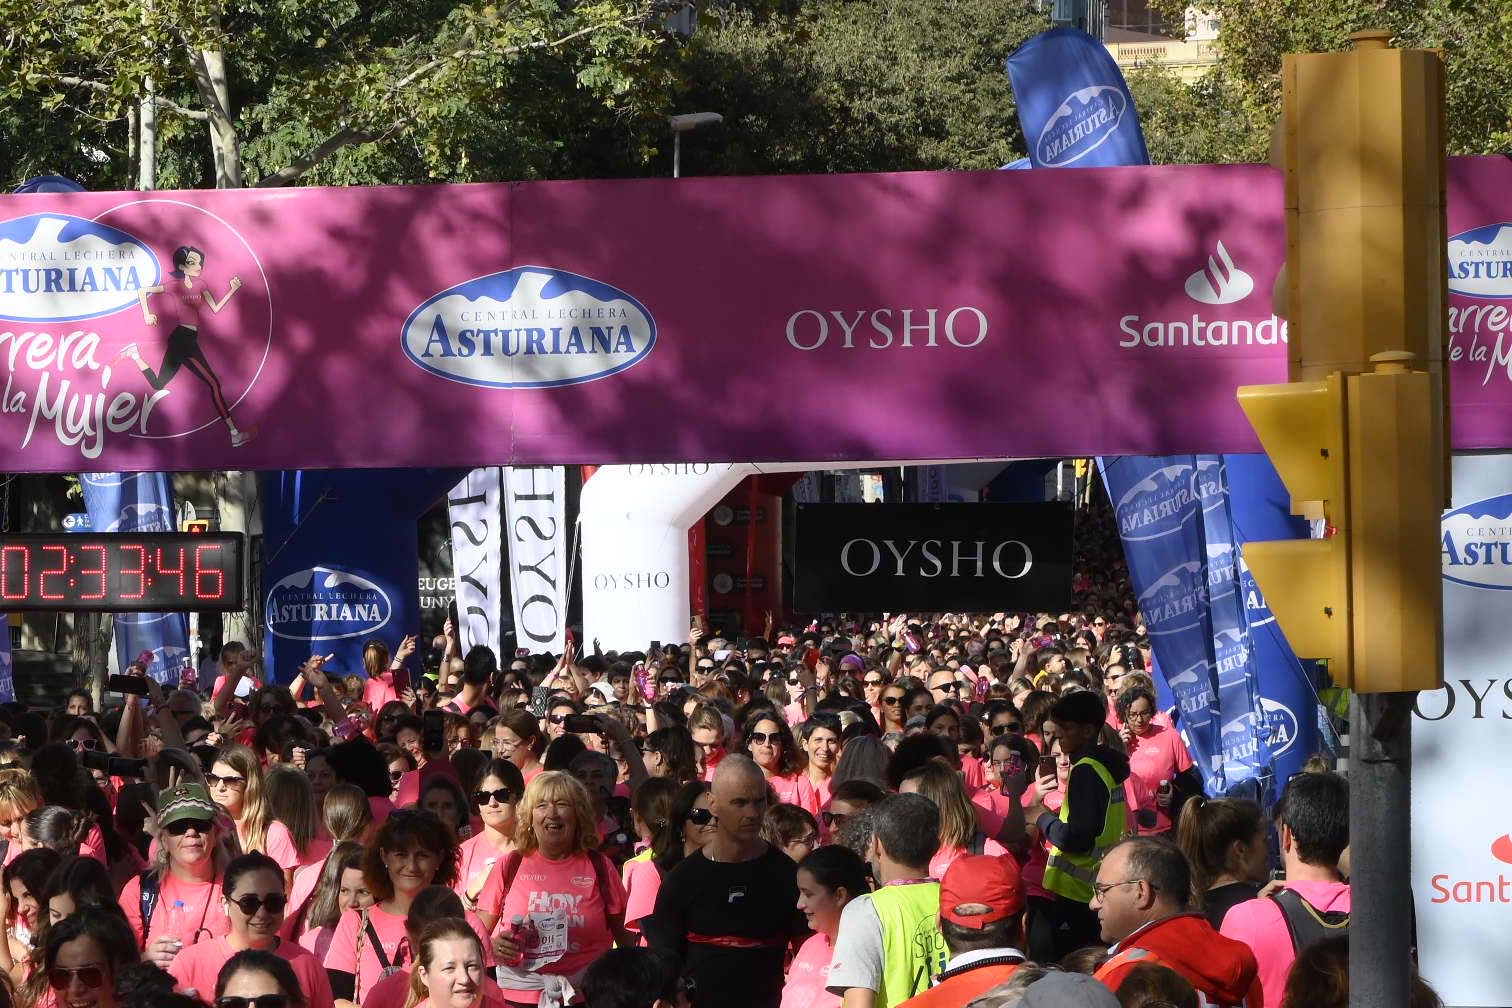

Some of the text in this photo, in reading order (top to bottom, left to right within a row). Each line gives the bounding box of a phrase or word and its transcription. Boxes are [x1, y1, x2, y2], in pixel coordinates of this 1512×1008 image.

[64, 249, 137, 260] LECHERA
[461, 307, 628, 322] CENTRAL LECHERA
[787, 306, 988, 350] OYSHO
[1448, 304, 1512, 333] arre
[420, 314, 637, 358] ASTURIANA
[1119, 313, 1287, 347] Santand
[1469, 336, 1487, 361] la
[2, 374, 26, 414] la
[21, 365, 171, 459] Mujer
[1466, 526, 1512, 537] CENT
[0, 545, 224, 599] 02:33:46
[840, 538, 1033, 579] OYSHO
[418, 577, 455, 590] EUGE
[594, 571, 670, 590] OYSHO
[268, 601, 382, 624] ASTURIANA
